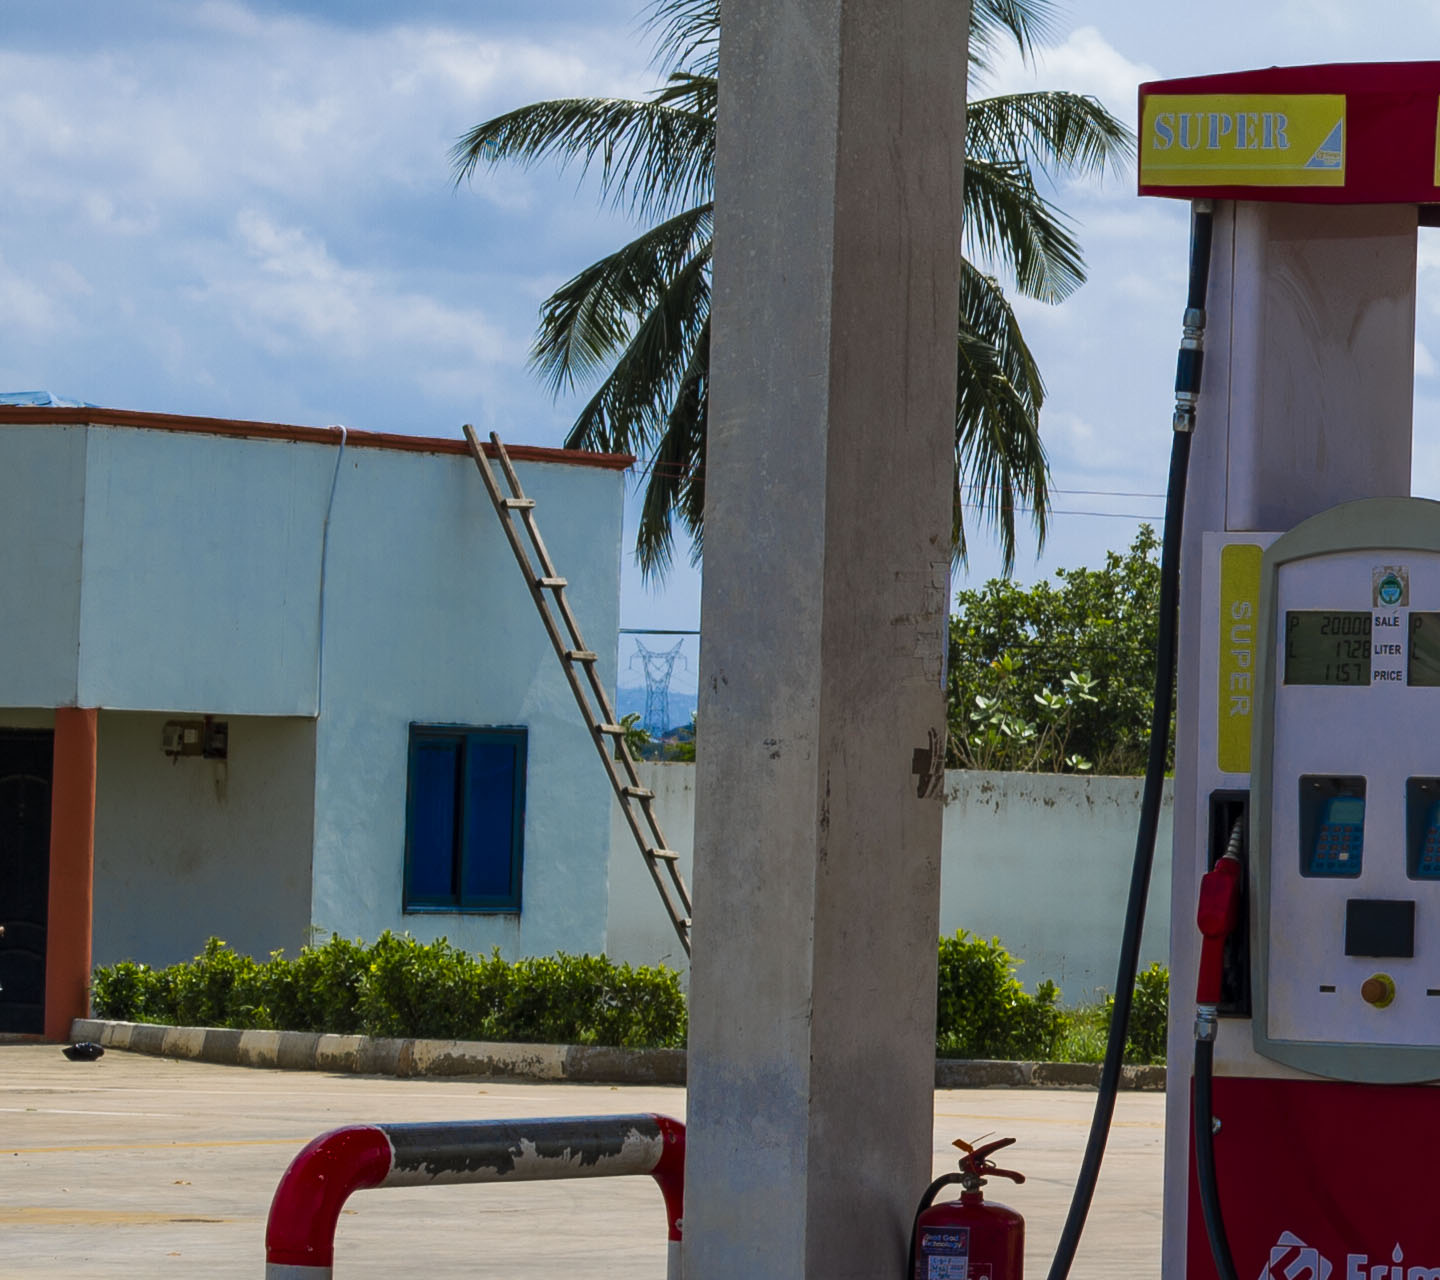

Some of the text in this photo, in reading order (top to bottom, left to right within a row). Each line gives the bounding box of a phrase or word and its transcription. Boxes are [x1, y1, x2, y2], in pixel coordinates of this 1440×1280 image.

[1152, 111, 1292, 150] SUPER
[1374, 616, 1400, 627] SALE
[1374, 644, 1402, 655] LITER
[1230, 600, 1252, 718] SUPER
[1373, 671, 1403, 681] PRICE
